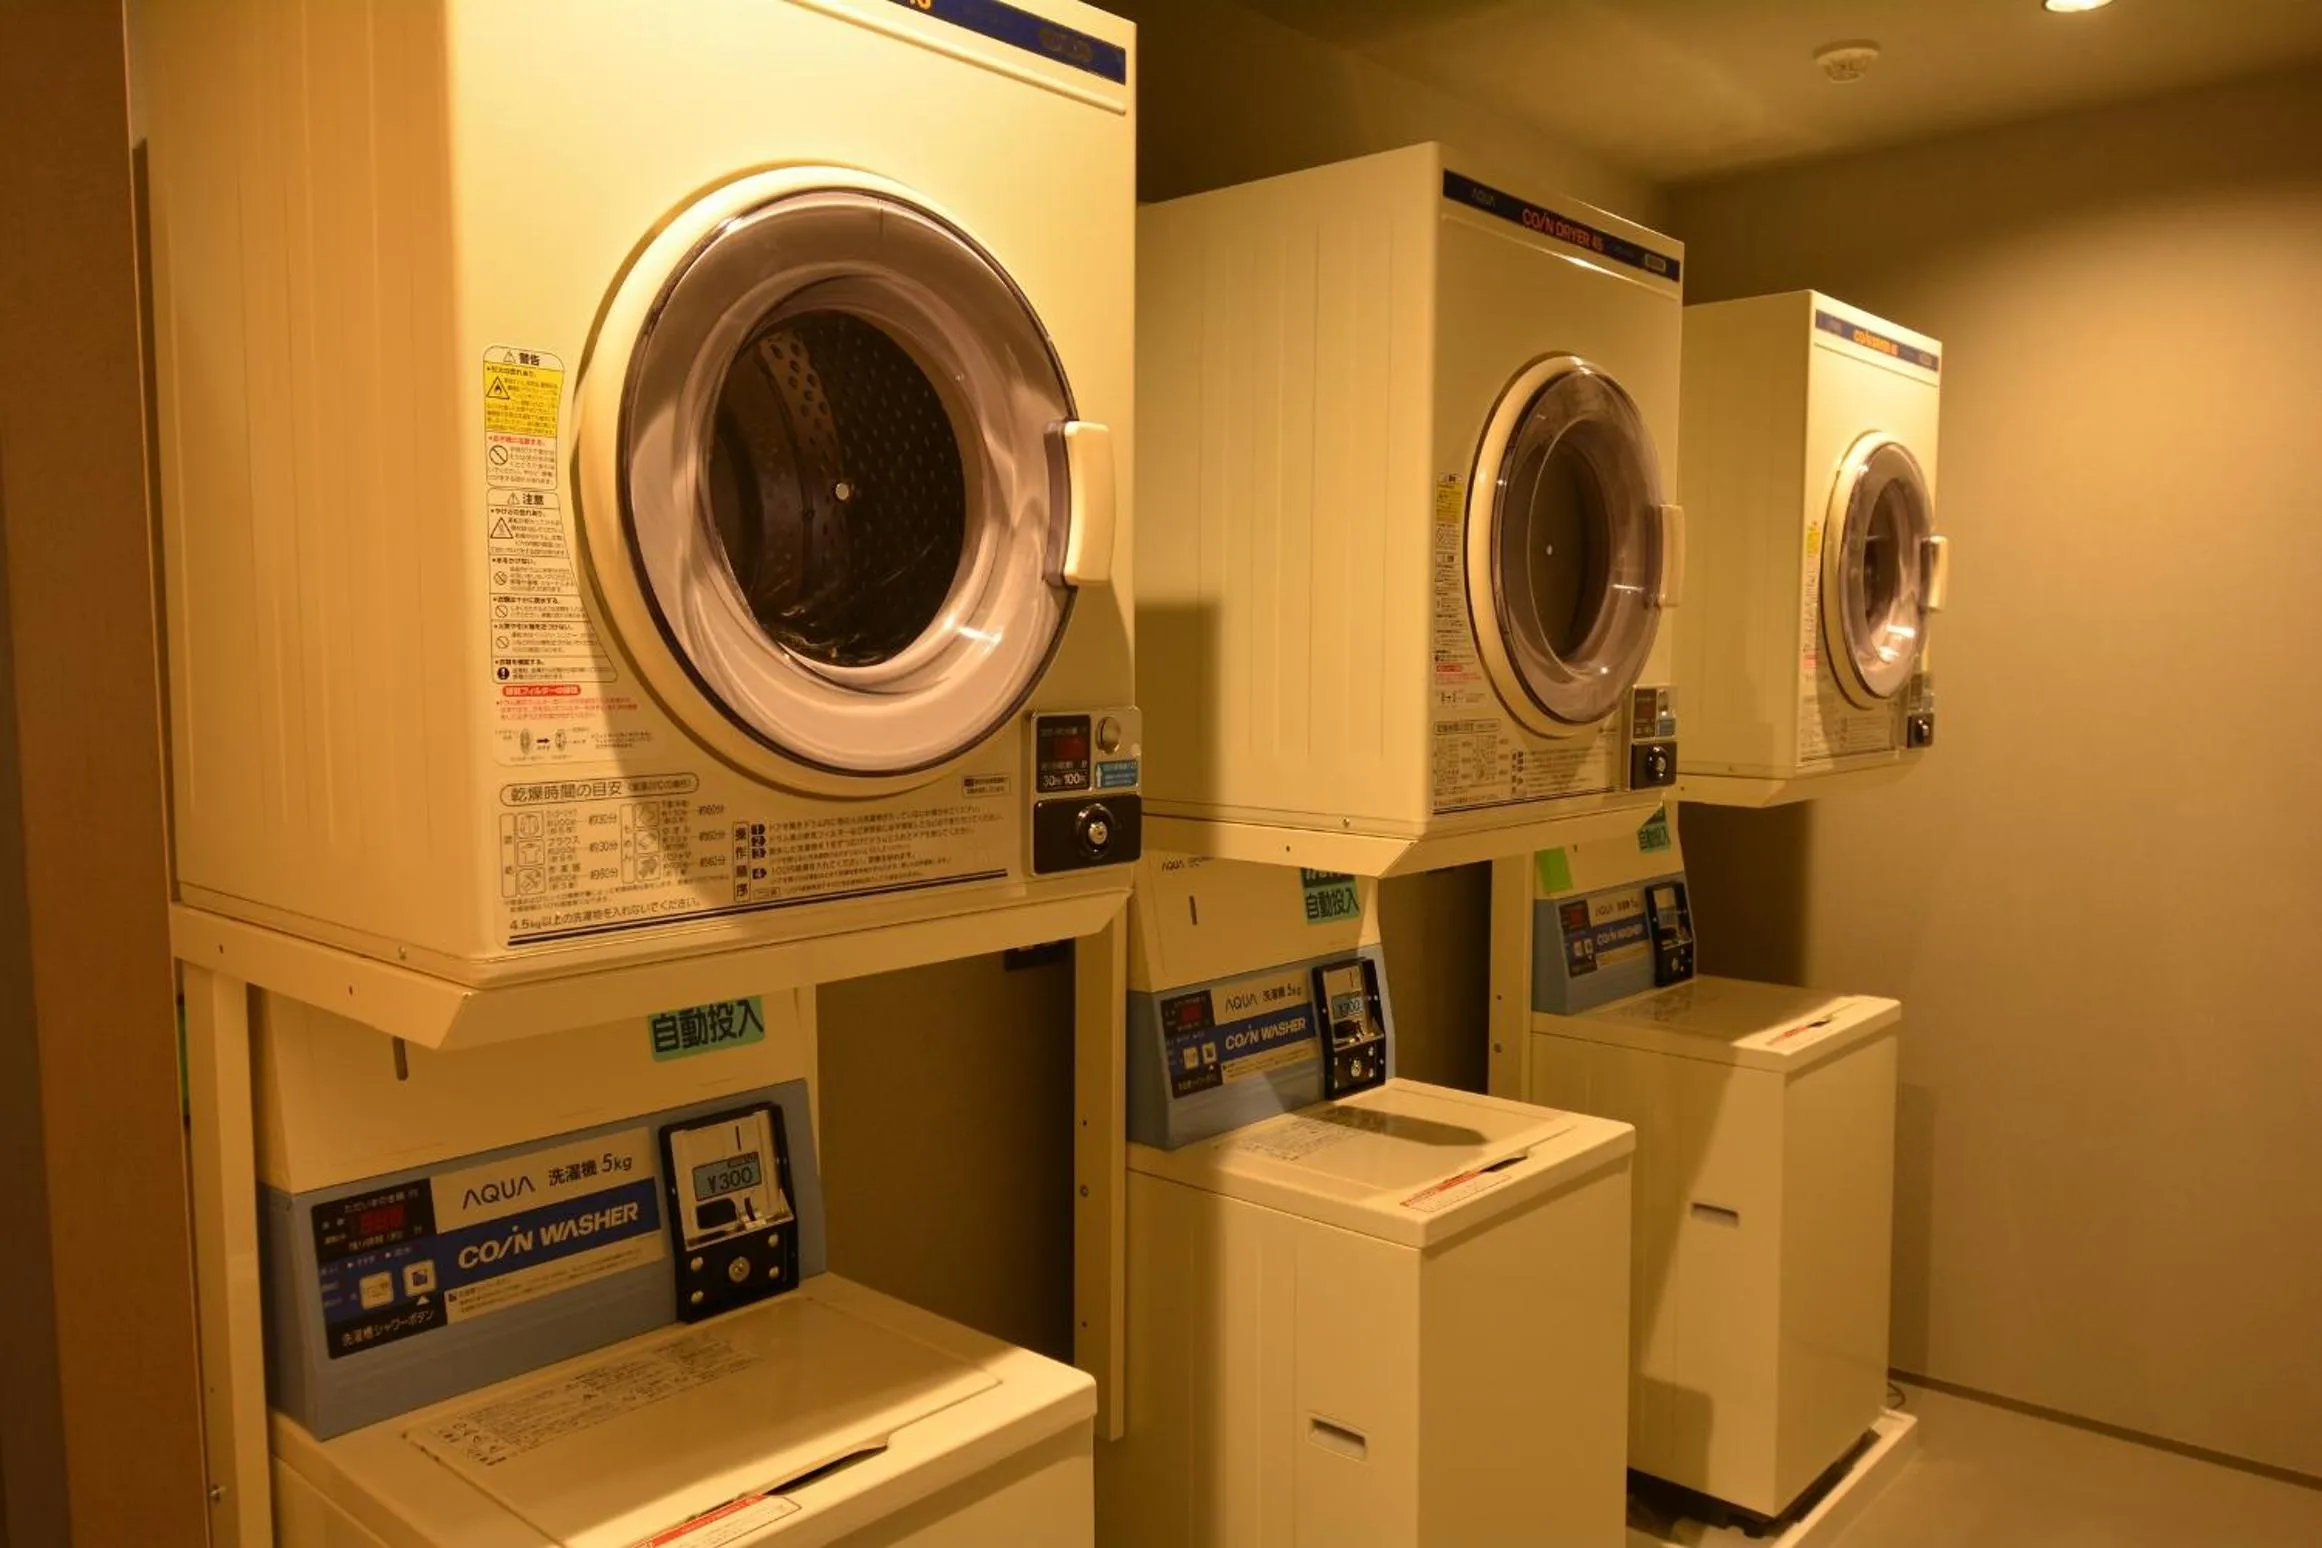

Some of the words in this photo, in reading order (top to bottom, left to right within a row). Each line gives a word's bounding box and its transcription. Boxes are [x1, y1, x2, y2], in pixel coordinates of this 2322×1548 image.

[1556, 221, 1590, 248] DRYER
[523, 493, 544, 505] 注意
[511, 780, 622, 803] 乾燥時間の目安
[1305, 887, 1361, 919] 自動投入
[1225, 993, 1258, 1014] AQUA
[652, 999, 764, 1052] 自動投入
[463, 1176, 536, 1210] AQUA
[548, 1159, 597, 1187] 洗濯機
[602, 1153, 633, 1173] 5kg
[458, 1225, 534, 1269] COIN
[540, 1202, 639, 1247] WASHER
